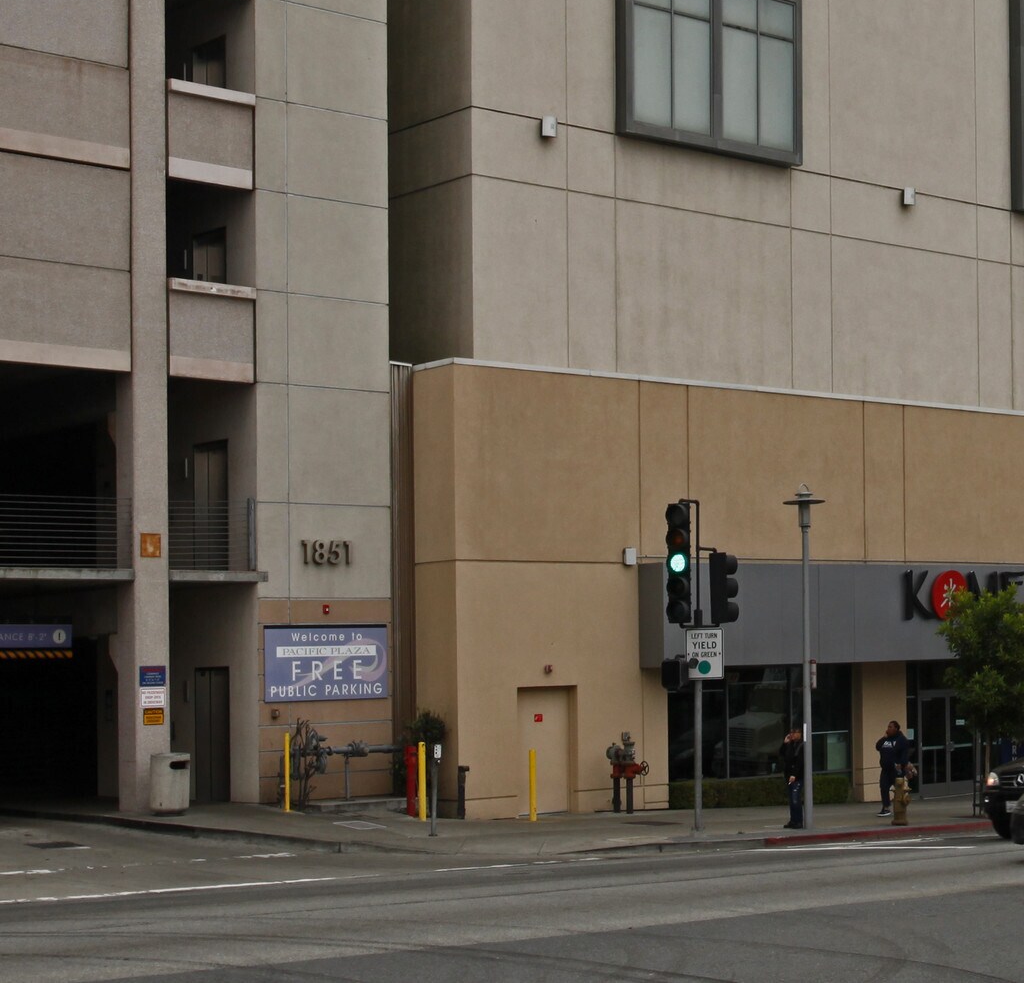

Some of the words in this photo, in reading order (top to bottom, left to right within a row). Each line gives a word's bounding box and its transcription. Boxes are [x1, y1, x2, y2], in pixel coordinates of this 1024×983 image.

[301, 539, 353, 565] 1851
[291, 632, 345, 642] Welcome
[351, 631, 363, 641] to
[282, 647, 328, 656] PACIFIC
[330, 646, 371, 655] PLAZA
[692, 641, 717, 649] YIELD
[291, 660, 363, 681] FREE
[270, 684, 318, 697] PUBLIC
[325, 682, 383, 696] PARKING
